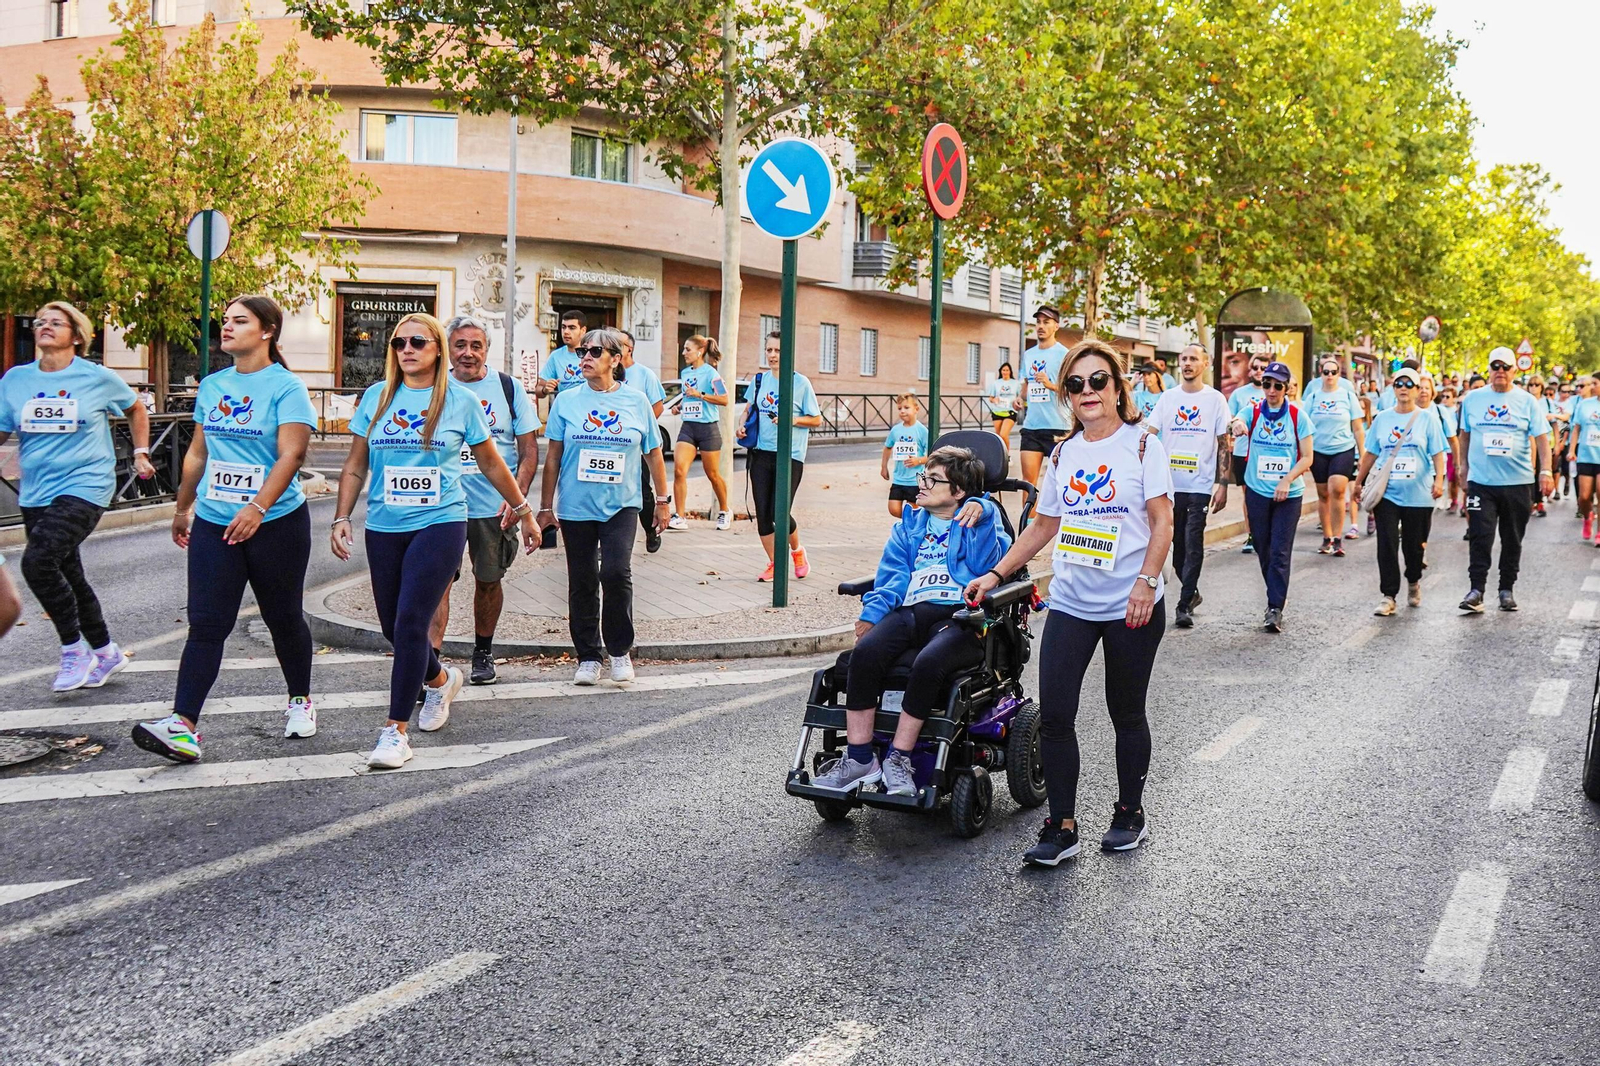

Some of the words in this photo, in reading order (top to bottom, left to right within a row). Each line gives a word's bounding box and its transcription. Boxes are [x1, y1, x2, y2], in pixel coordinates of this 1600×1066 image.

[351, 300, 427, 312] CHURRERÍA
[1233, 339, 1289, 356] Freshly
[34, 407, 64, 418] 634
[572, 434, 632, 443] CARRERA-MARCHA
[589, 458, 614, 470] 558
[214, 472, 252, 487] 1071
[391, 477, 432, 489] 1069
[1060, 533, 1113, 552] VOLUNTARIO
[919, 573, 950, 588] 709
